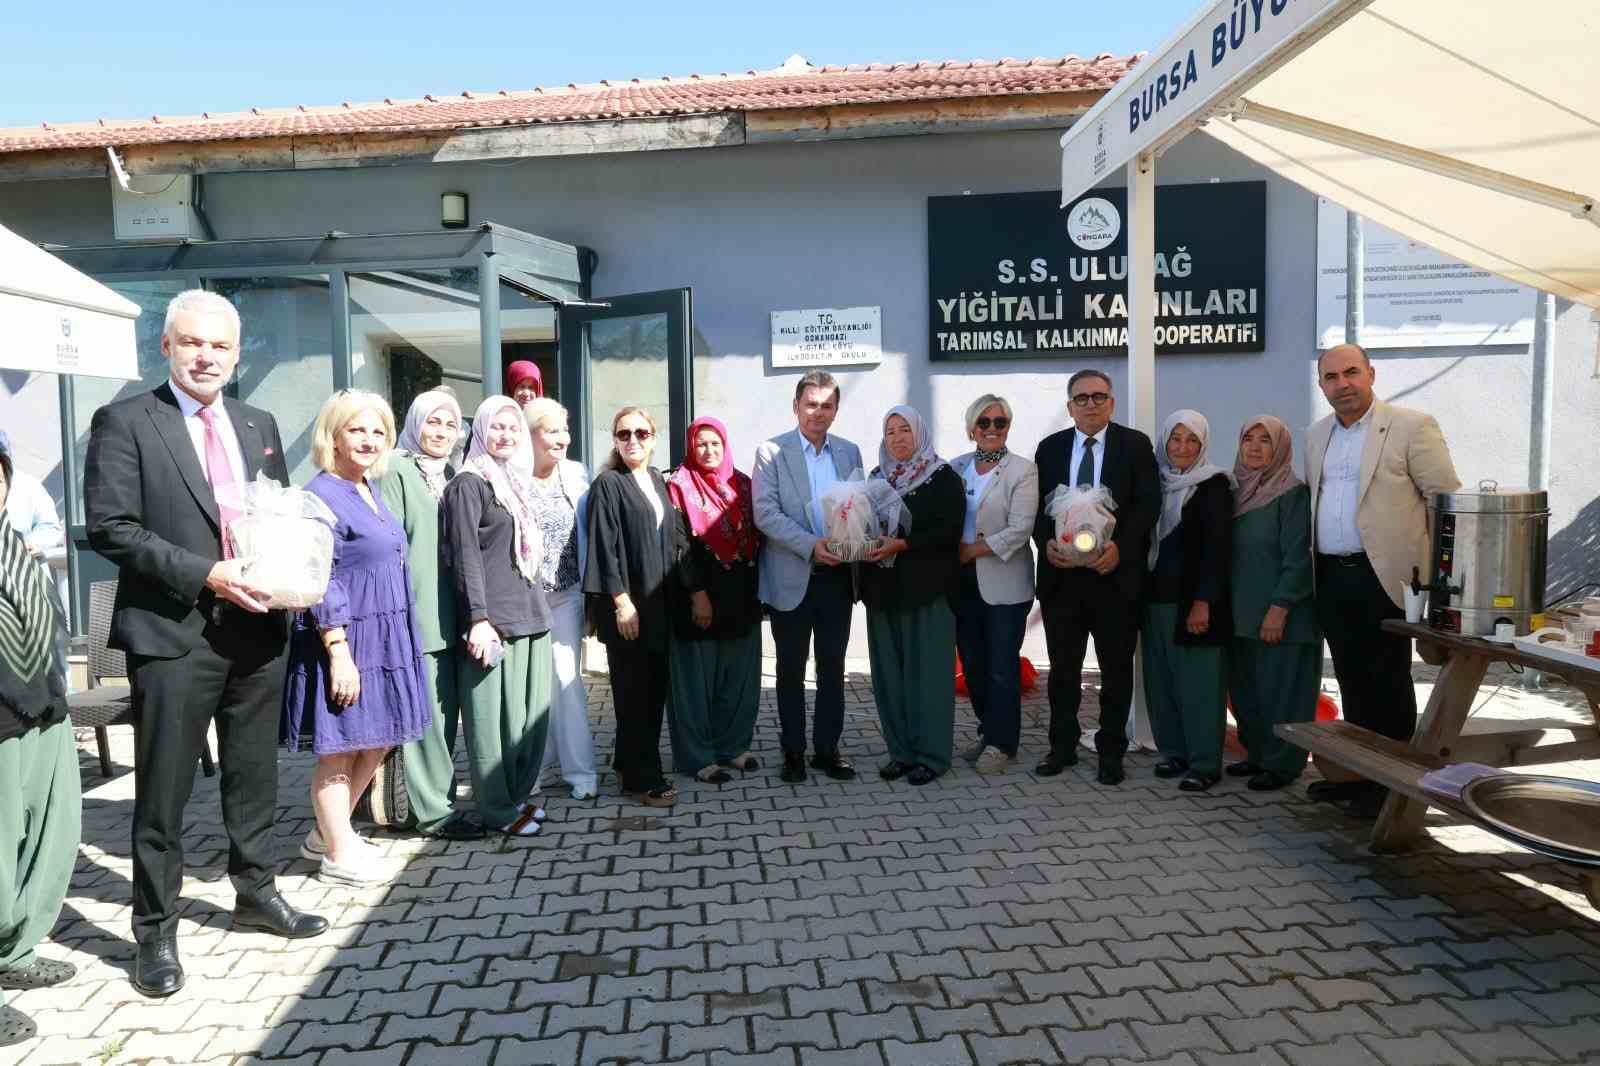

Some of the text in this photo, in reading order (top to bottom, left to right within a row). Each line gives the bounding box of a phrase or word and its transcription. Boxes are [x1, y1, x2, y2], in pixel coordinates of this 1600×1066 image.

[1129, 48, 1198, 134] BURSA
[998, 245, 1193, 284] S.S. ULUAĞ
[937, 288, 1257, 323] YİĞİTALİ KAINLARI
[937, 322, 1257, 351] TARIMSAL KALKINMA OOPERATİFİ
